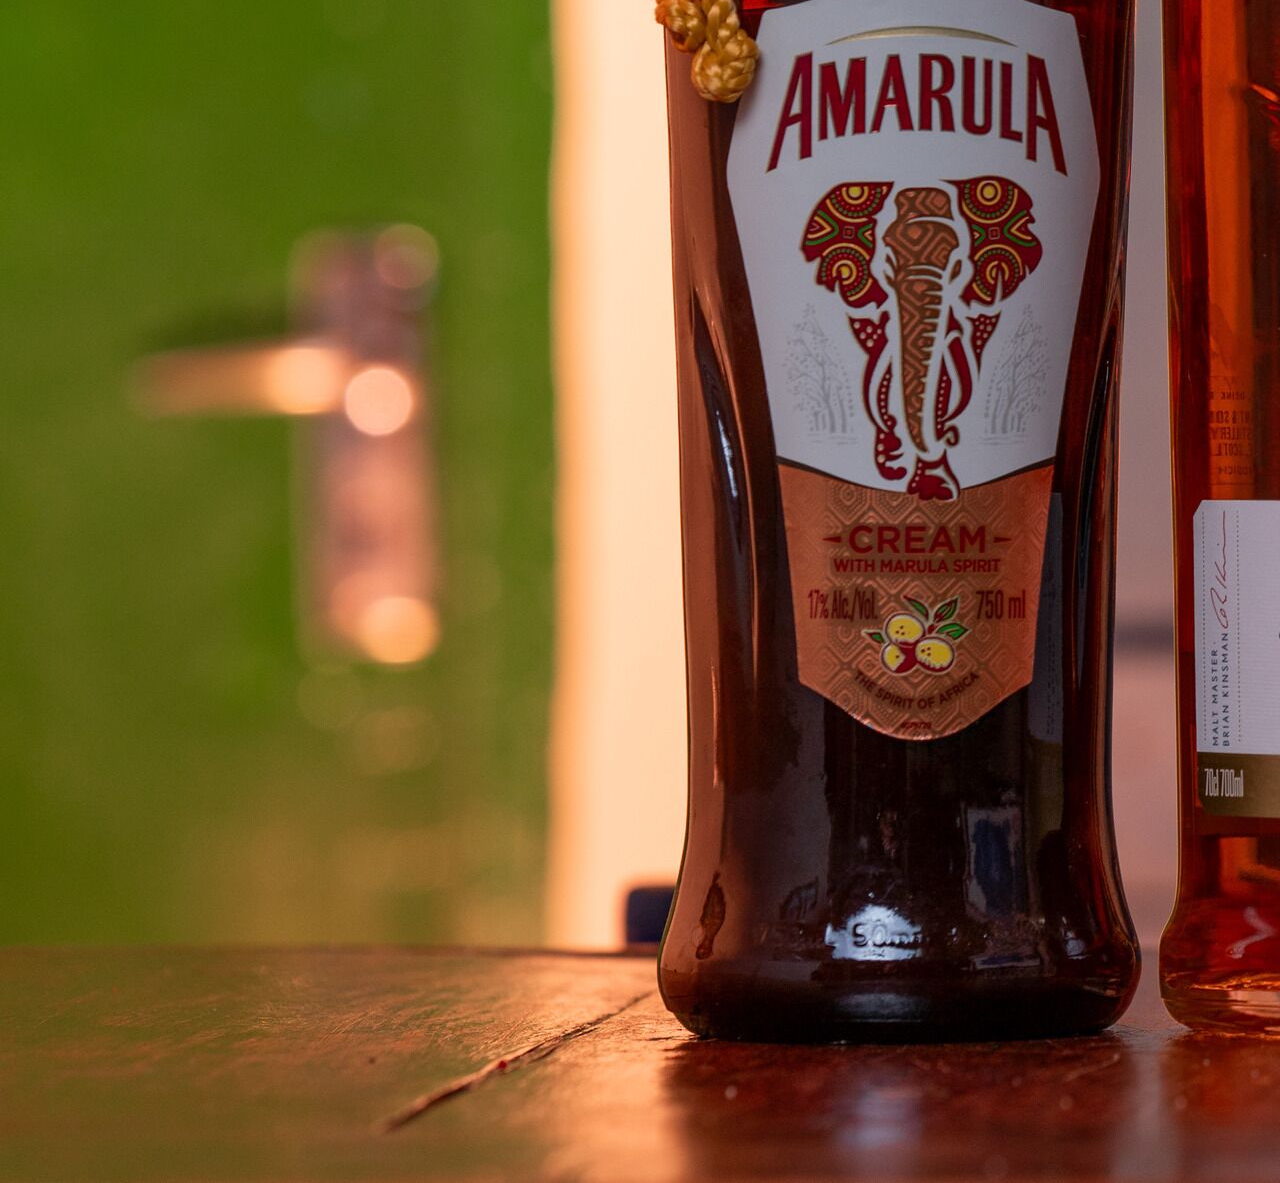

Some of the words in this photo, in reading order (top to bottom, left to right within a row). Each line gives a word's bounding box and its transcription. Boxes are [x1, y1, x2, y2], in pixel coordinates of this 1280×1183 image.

[765, 51, 1068, 177] AMARULA
[849, 525, 986, 554] CREAM
[833, 558, 875, 573] WITH
[879, 558, 948, 573] MARULA
[953, 558, 1000, 573] SPIRIT
[808, 589, 828, 619] 17%
[976, 590, 1003, 620] 750
[1007, 589, 1026, 620] ml
[1211, 649, 1219, 704] MASTER
[1221, 632, 1229, 697] KINSMAN
[853, 670, 876, 692] THE
[875, 688, 914, 710] SPIRIT
[918, 697, 936, 710] OF
[939, 671, 980, 705] AFRICA
[1222, 705, 1230, 747] BRIAN
